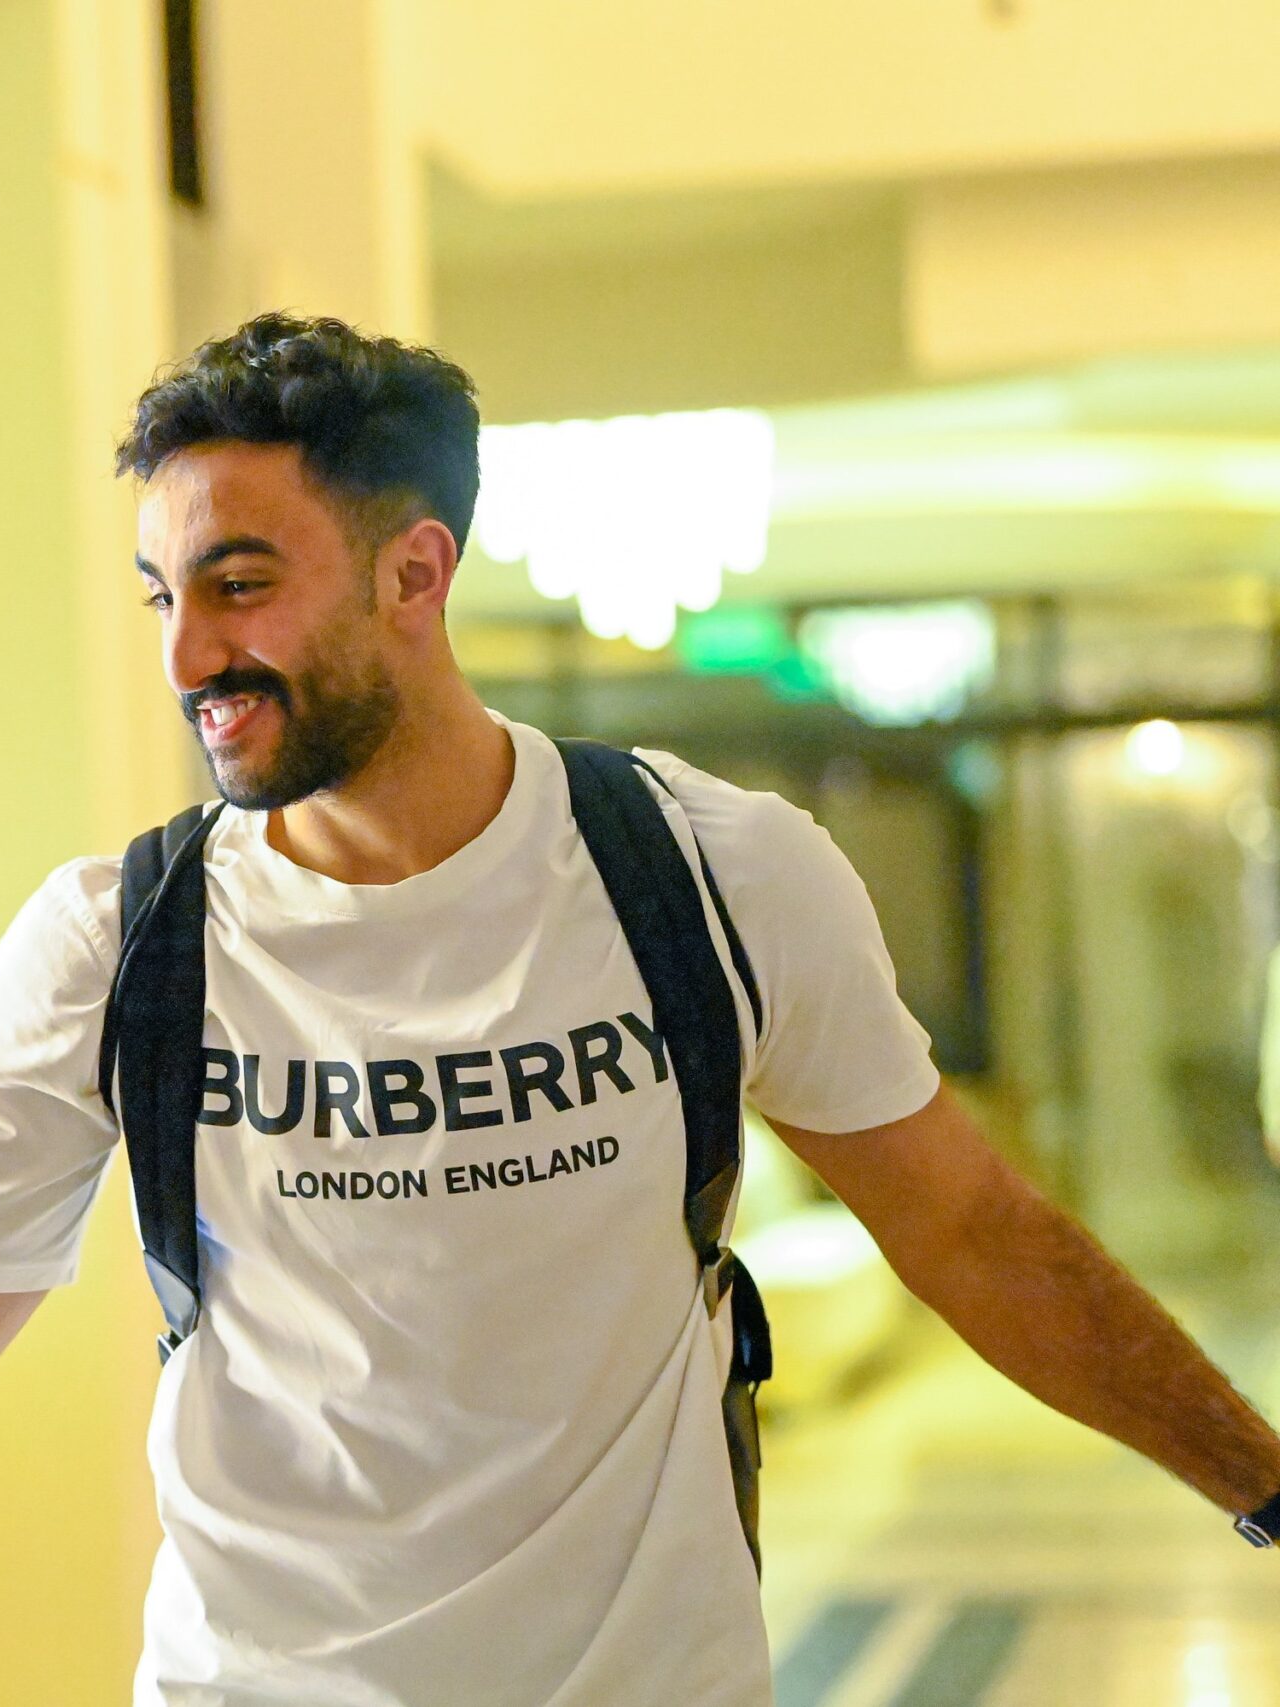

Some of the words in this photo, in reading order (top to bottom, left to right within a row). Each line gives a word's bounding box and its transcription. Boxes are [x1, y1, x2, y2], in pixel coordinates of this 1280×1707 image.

[198, 1012, 669, 1139] BURBERRY
[277, 1169, 428, 1200] LONDON
[445, 1136, 620, 1194] ENGLAND
